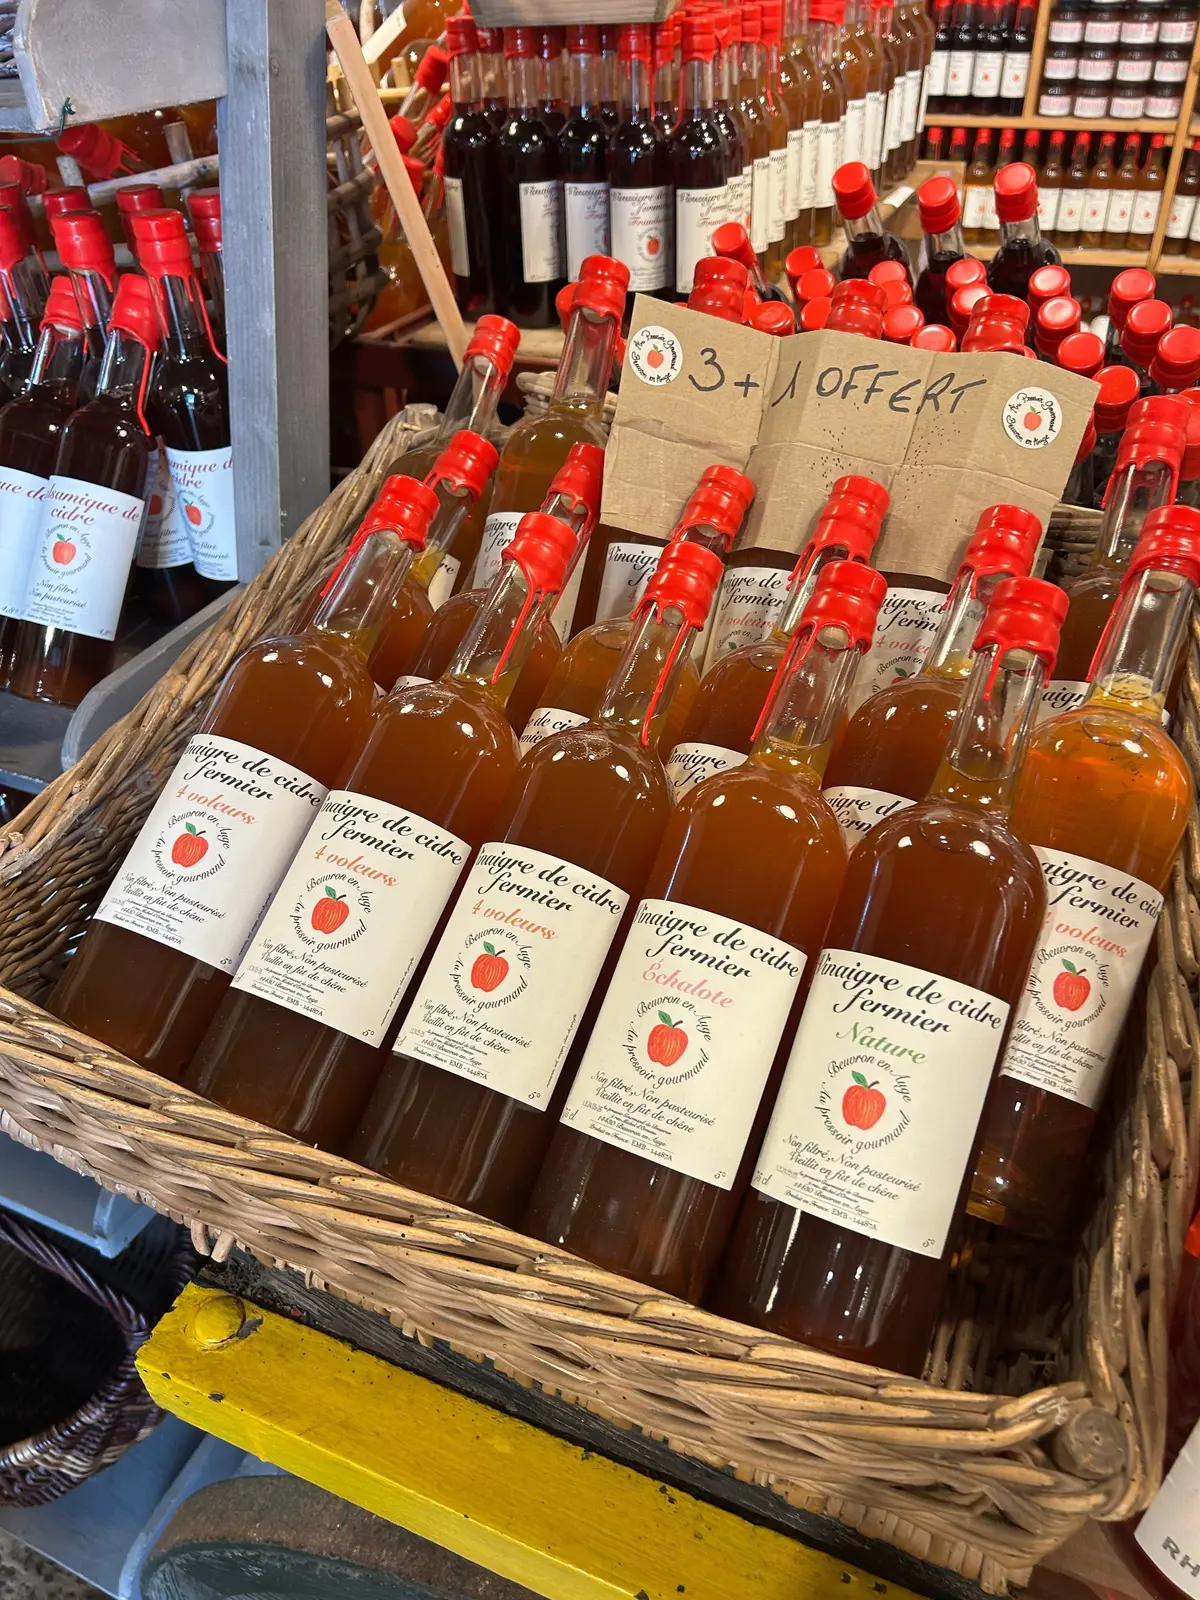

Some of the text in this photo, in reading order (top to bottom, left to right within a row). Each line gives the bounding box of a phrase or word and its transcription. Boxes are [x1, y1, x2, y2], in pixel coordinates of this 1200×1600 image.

[688, 347, 988, 415] 3 + 1 OFFERT
[50, 505, 96, 526] cidre
[122, 503, 139, 522] de
[37, 579, 79, 595] Non filtré
[40, 592, 88, 609] pasteurisé
[721, 587, 786, 611] fermier
[759, 572, 784, 589] de
[876, 634, 887, 648] 4
[876, 654, 924, 676] Beuvron en
[533, 711, 551, 727] de
[184, 740, 322, 807] inaigre de cidre
[184, 760, 275, 800] fermier
[175, 784, 258, 825] 4 voleurs
[167, 809, 235, 850] Beuvron en Auge
[321, 794, 464, 865] inaigre de cidre
[321, 819, 416, 861] fermier
[151, 848, 177, 880] pressoir
[171, 853, 226, 885] gourmand
[314, 844, 399, 887] 4 voleurs
[475, 847, 622, 915] inaigre de cidre
[121, 872, 136, 887] Non
[155, 884, 177, 898] Non
[174, 893, 228, 920] pasteurisé
[122, 884, 143, 899] Vieillit
[143, 894, 153, 905] en
[167, 901, 179, 912] de
[179, 906, 206, 924] chêne
[306, 872, 374, 914] Beuvron en Auge
[477, 872, 573, 912] fermier
[1049, 884, 1141, 930] fermier
[1111, 881, 1139, 904] de
[289, 914, 317, 946] pressoir
[311, 918, 368, 954] gourmand
[471, 899, 557, 940] 4 voleurs
[1055, 921, 1128, 958] voleurs
[259, 938, 275, 953] Non
[294, 952, 318, 967] Non
[314, 961, 369, 988] pasteurisé
[464, 927, 533, 970] Beuvron en Auge
[645, 934, 752, 979] fermier
[713, 927, 800, 978] de cidre
[1037, 944, 1097, 965] Beuvron en
[261, 951, 282, 968] Vieillit
[282, 963, 293, 974] en
[307, 969, 320, 981] de
[320, 975, 347, 993] chêne
[449, 972, 477, 1006] pressoir
[472, 974, 529, 1013] gourmand
[642, 959, 736, 1009] Échalote
[419, 998, 435, 1014] Non
[455, 1012, 479, 1027] Non
[478, 1021, 533, 1049] pasteurisé
[636, 995, 713, 1042] Beuvron en Auge
[832, 987, 953, 1034] fermier
[906, 979, 945, 1005] de
[948, 998, 1002, 1030] cidre
[1026, 986, 1064, 1025] pressoir
[1060, 993, 1107, 1033] gourmand
[362, 1028, 375, 1037] 5°
[421, 1013, 446, 1030] Vieillit
[444, 1023, 455, 1035] en
[469, 1031, 483, 1043] de
[483, 1037, 511, 1055] chêne
[836, 1021, 929, 1065] Nature
[1011, 1033, 1032, 1047] illit
[1032, 1042, 1046, 1056] en
[1061, 1051, 1073, 1062] de
[1072, 1057, 1095, 1072] chêne
[1043, 1030, 1068, 1047] Non
[622, 1043, 656, 1081] pressoir
[652, 1048, 711, 1090] gourmand
[827, 1054, 912, 1103] Beuvron en Auge
[528, 1091, 542, 1100] 5°
[590, 1070, 608, 1087] Non
[633, 1087, 661, 1104] Non
[657, 1097, 716, 1127] pasteurisé
[595, 1086, 623, 1106] Vieillit
[622, 1099, 635, 1113] en
[650, 1109, 666, 1123] de
[665, 1116, 696, 1134] chêne
[631, 1139, 647, 1151] EMB
[815, 1104, 854, 1146] pressoir
[849, 1109, 912, 1155] gourmand
[714, 1170, 727, 1180] 5°
[782, 1133, 803, 1150] Non
[831, 1152, 860, 1171] Non
[856, 1164, 922, 1193] pasteurisé
[789, 1151, 820, 1171] Vieillit
[819, 1165, 832, 1178] en
[850, 1175, 867, 1190] de
[867, 1182, 900, 1201] chêne
[830, 1208, 849, 1220] EMB
[922, 1237, 937, 1248] 5°
